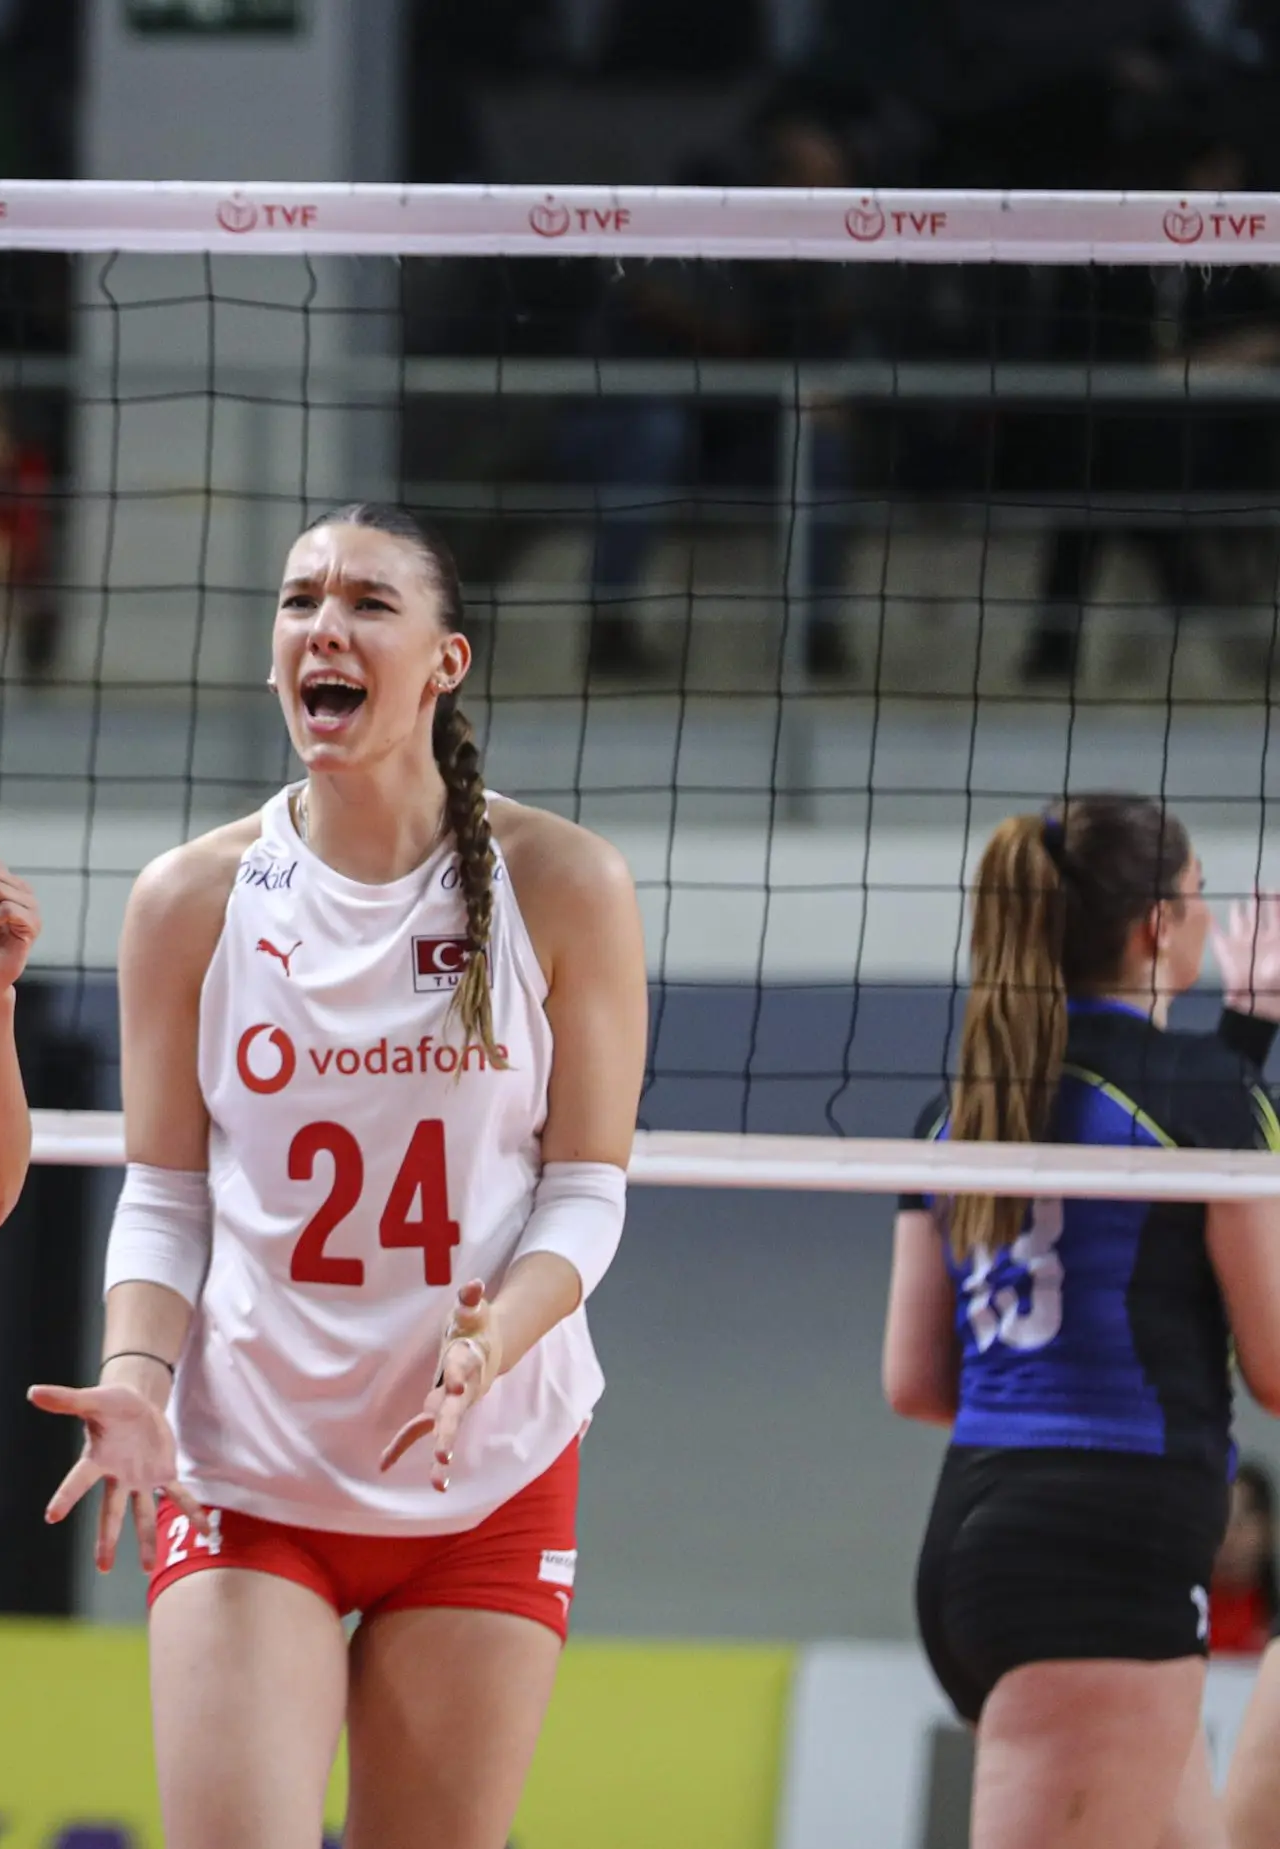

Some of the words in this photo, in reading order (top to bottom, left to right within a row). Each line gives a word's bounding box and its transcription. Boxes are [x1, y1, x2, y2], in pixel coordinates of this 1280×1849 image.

[262, 203, 317, 228] TVF
[576, 208, 631, 232] TVF
[890, 211, 946, 236] TVF
[1209, 213, 1266, 238] TVF
[433, 976, 460, 987] TU
[287, 1119, 460, 1286] 24
[165, 1508, 223, 1568] 24
